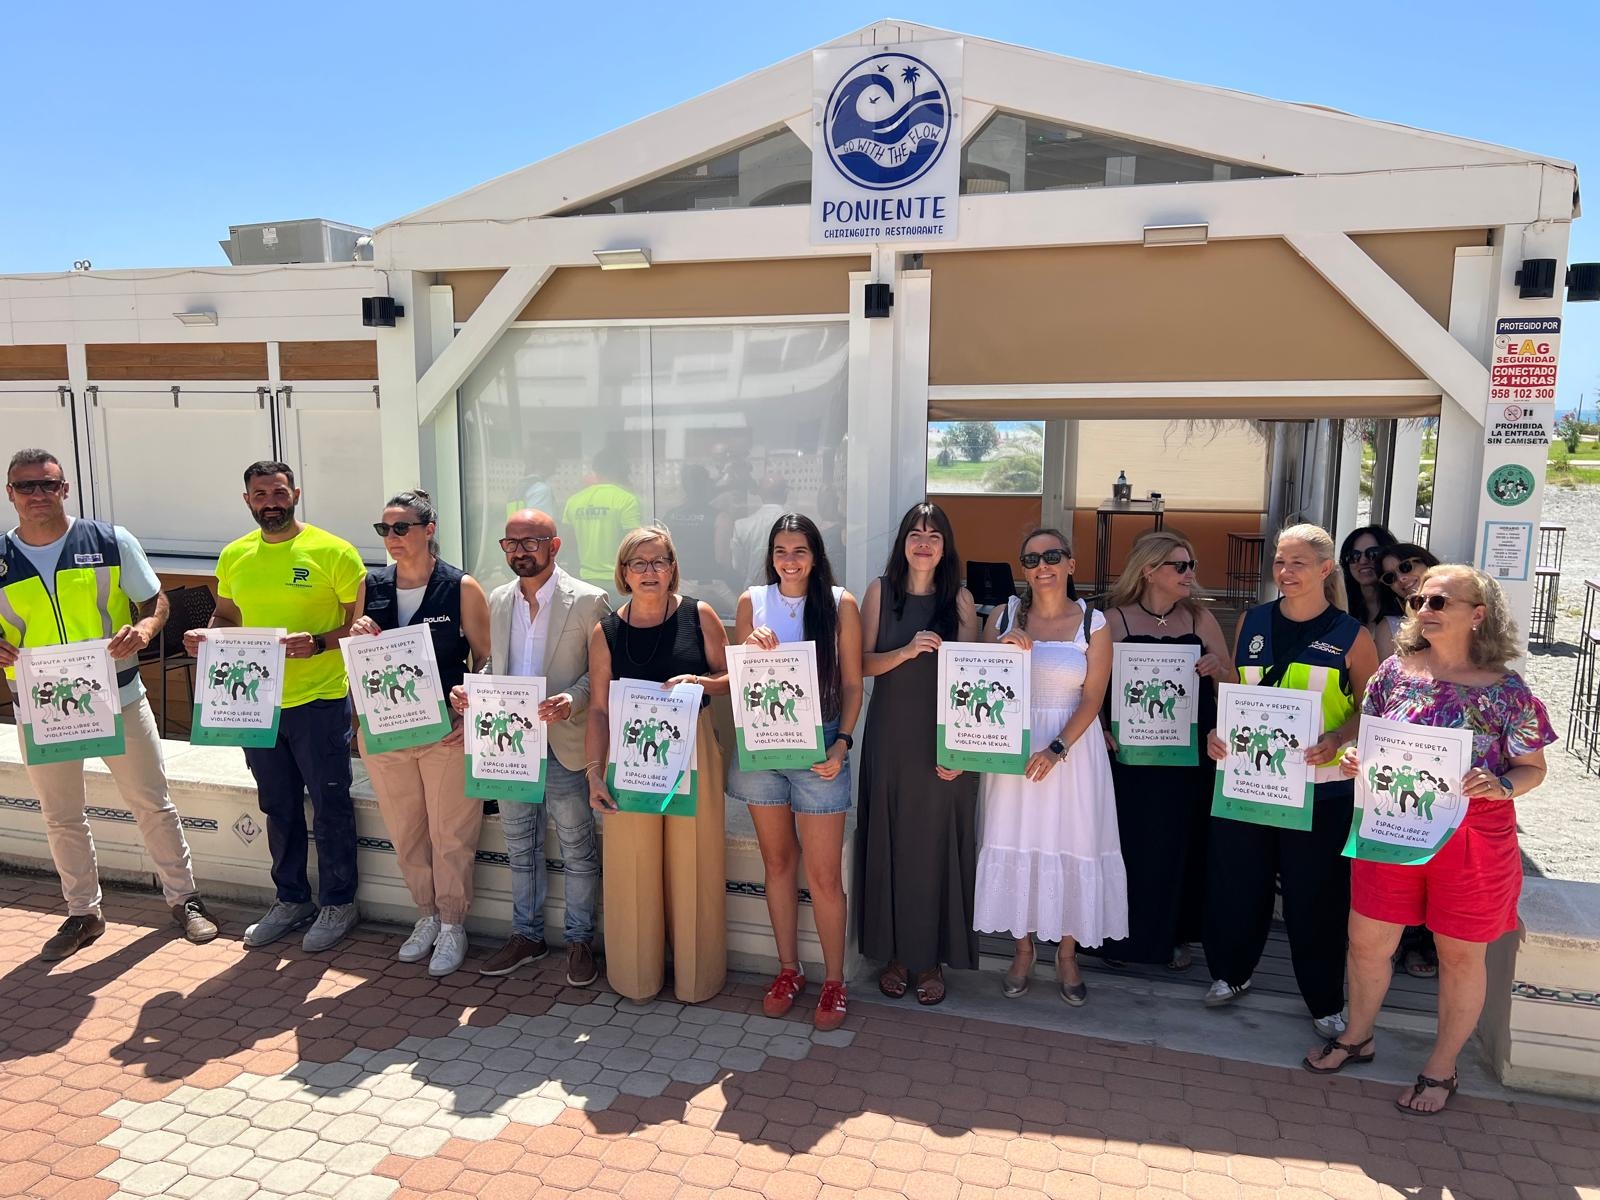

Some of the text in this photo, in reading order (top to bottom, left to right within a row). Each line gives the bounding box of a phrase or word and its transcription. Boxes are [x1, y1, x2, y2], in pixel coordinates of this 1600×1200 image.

[844, 125, 941, 164] GO WITH THE FLOW
[823, 197, 946, 222] PONIENTE
[825, 225, 943, 238] CHIRINGUITO RESTAURANTE
[1507, 340, 1549, 355] EAG
[1494, 367, 1554, 375] CONECTADO
[1492, 389, 1554, 398] 958 102 300
[1375, 735, 1405, 745] DISFRUTA
[1415, 743, 1447, 752] RESPETA
[1236, 780, 1259, 788] ESPACIO
[1267, 791, 1292, 799] SEXUAL
[1376, 820, 1401, 830] ESPACIO
[1371, 828, 1404, 839] VIOLENCIA
